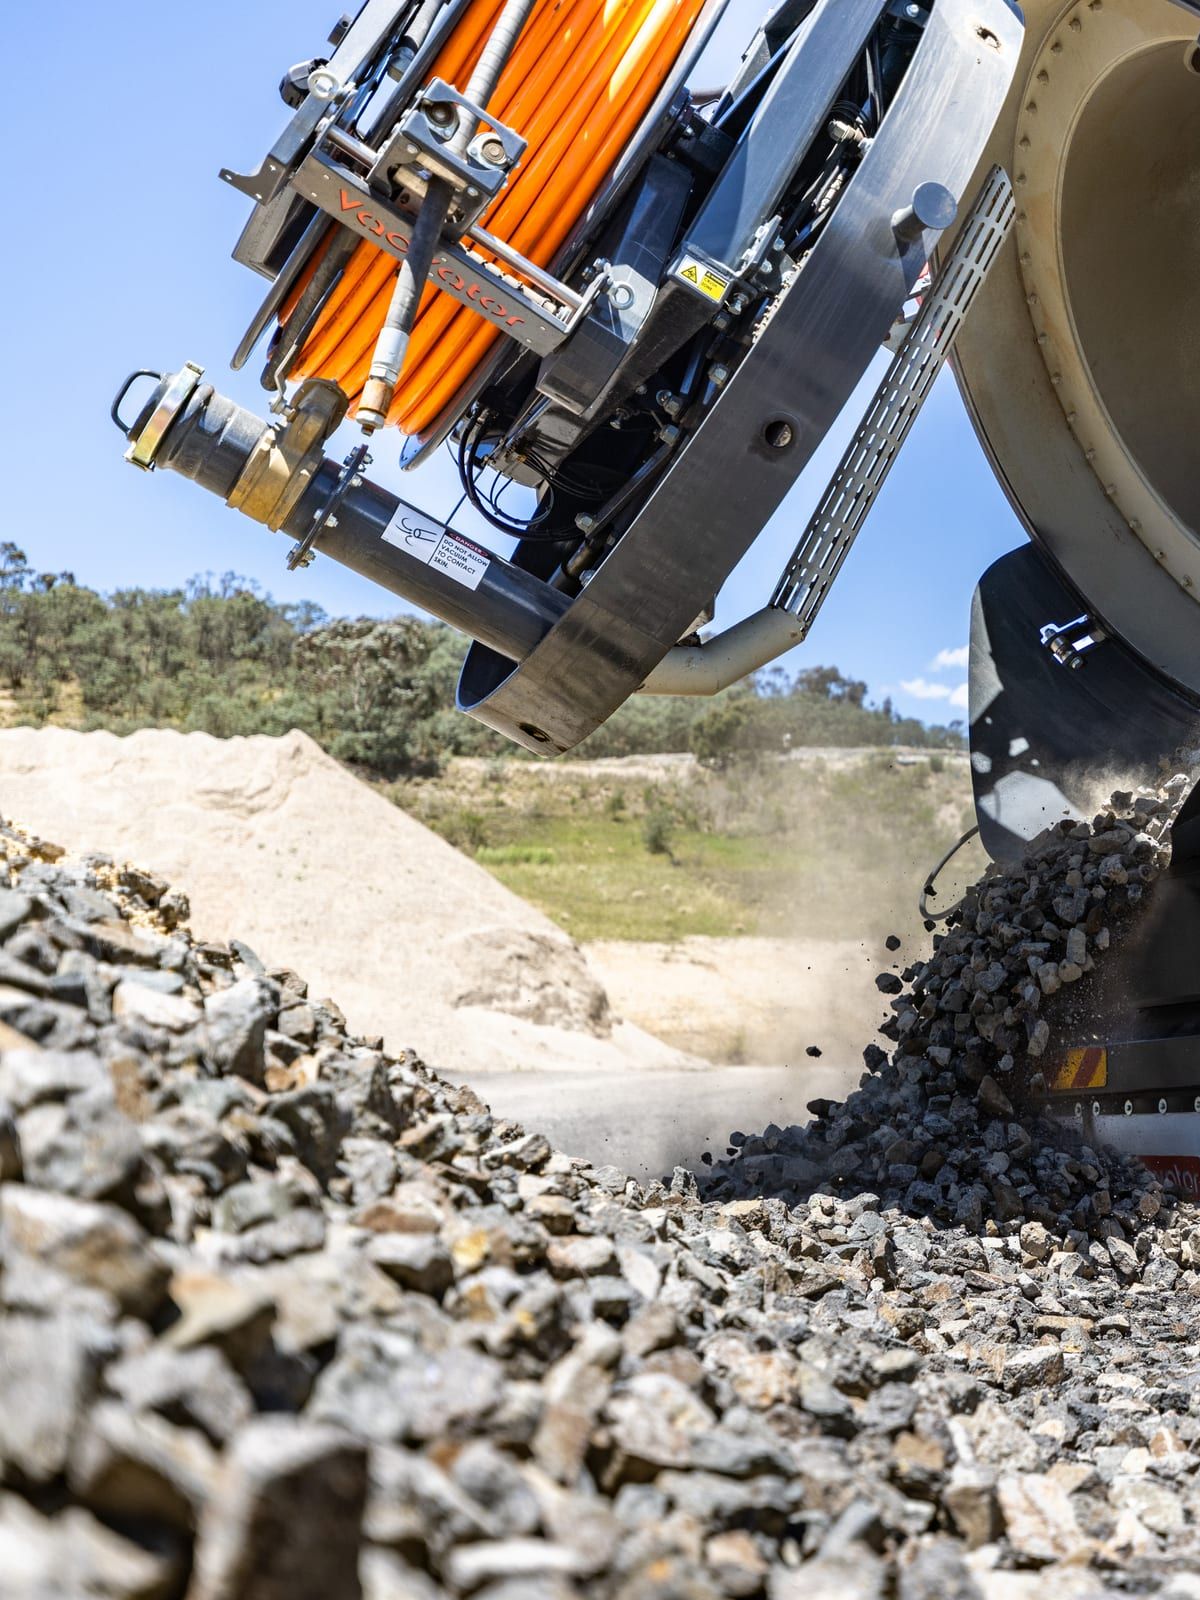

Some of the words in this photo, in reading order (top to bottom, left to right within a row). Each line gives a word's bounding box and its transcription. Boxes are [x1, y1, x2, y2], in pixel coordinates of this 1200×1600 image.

[340, 190, 525, 328] Vacator
[434, 557, 448, 568] SKIN.
[437, 550, 446, 558] TO
[446, 556, 476, 575] CONTACT
[442, 544, 468, 562] VACUUM
[444, 539, 454, 548] DO
[454, 544, 468, 556] NOT
[468, 551, 489, 567] ALLOW
